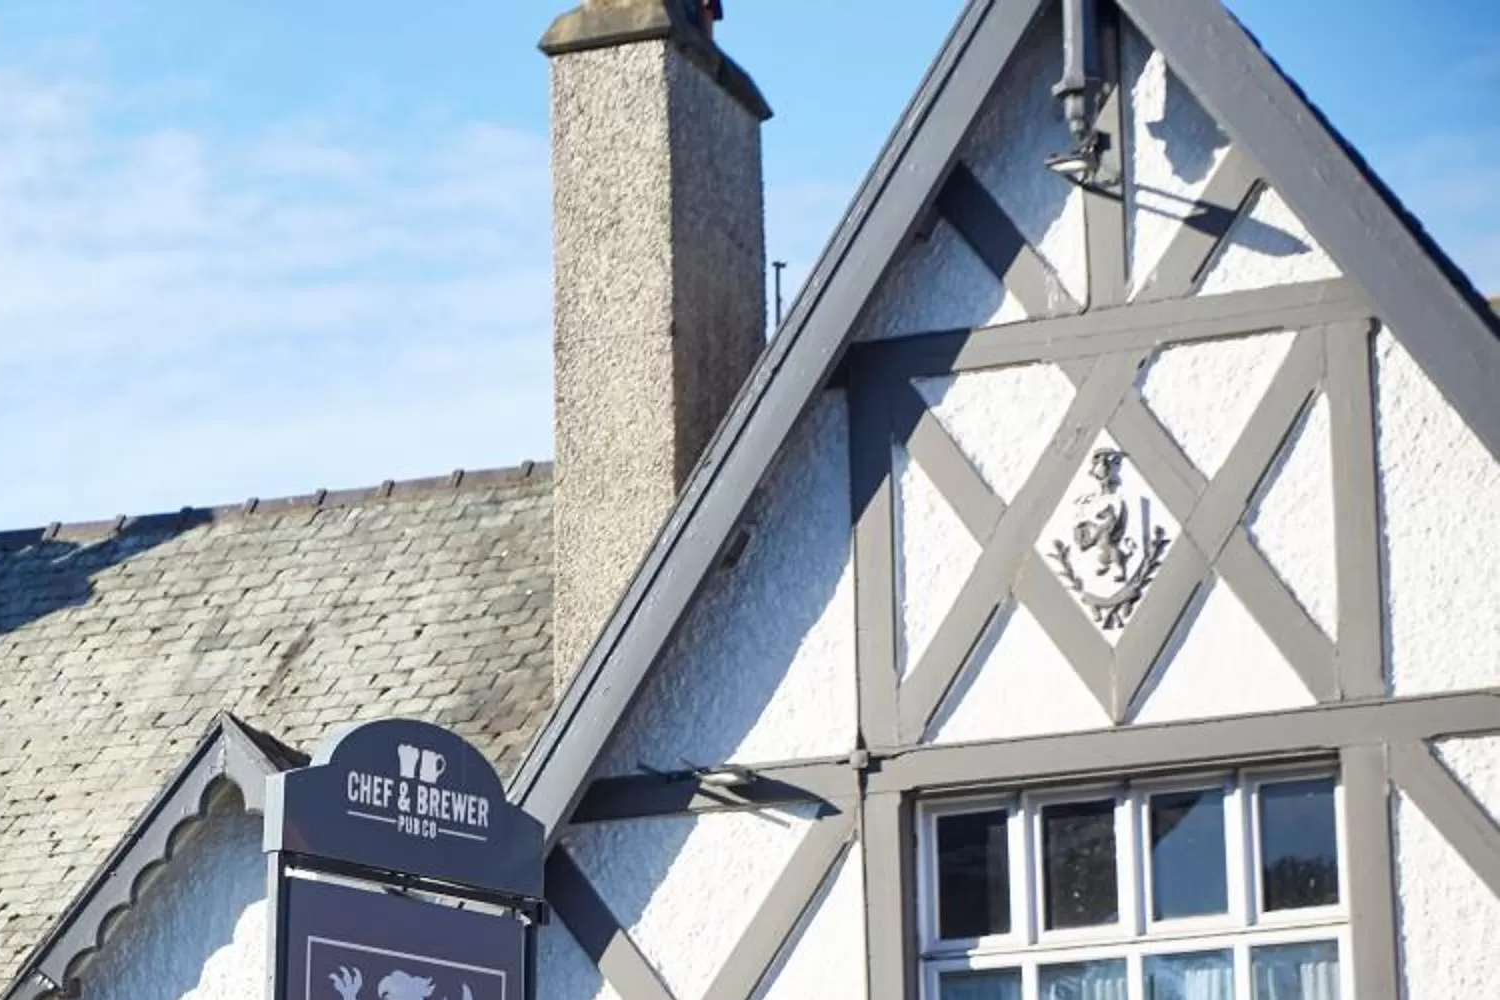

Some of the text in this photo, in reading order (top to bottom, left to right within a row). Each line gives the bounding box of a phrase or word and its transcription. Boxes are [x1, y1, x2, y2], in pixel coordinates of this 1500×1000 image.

[347, 771, 488, 827] CHEF & BREWER
